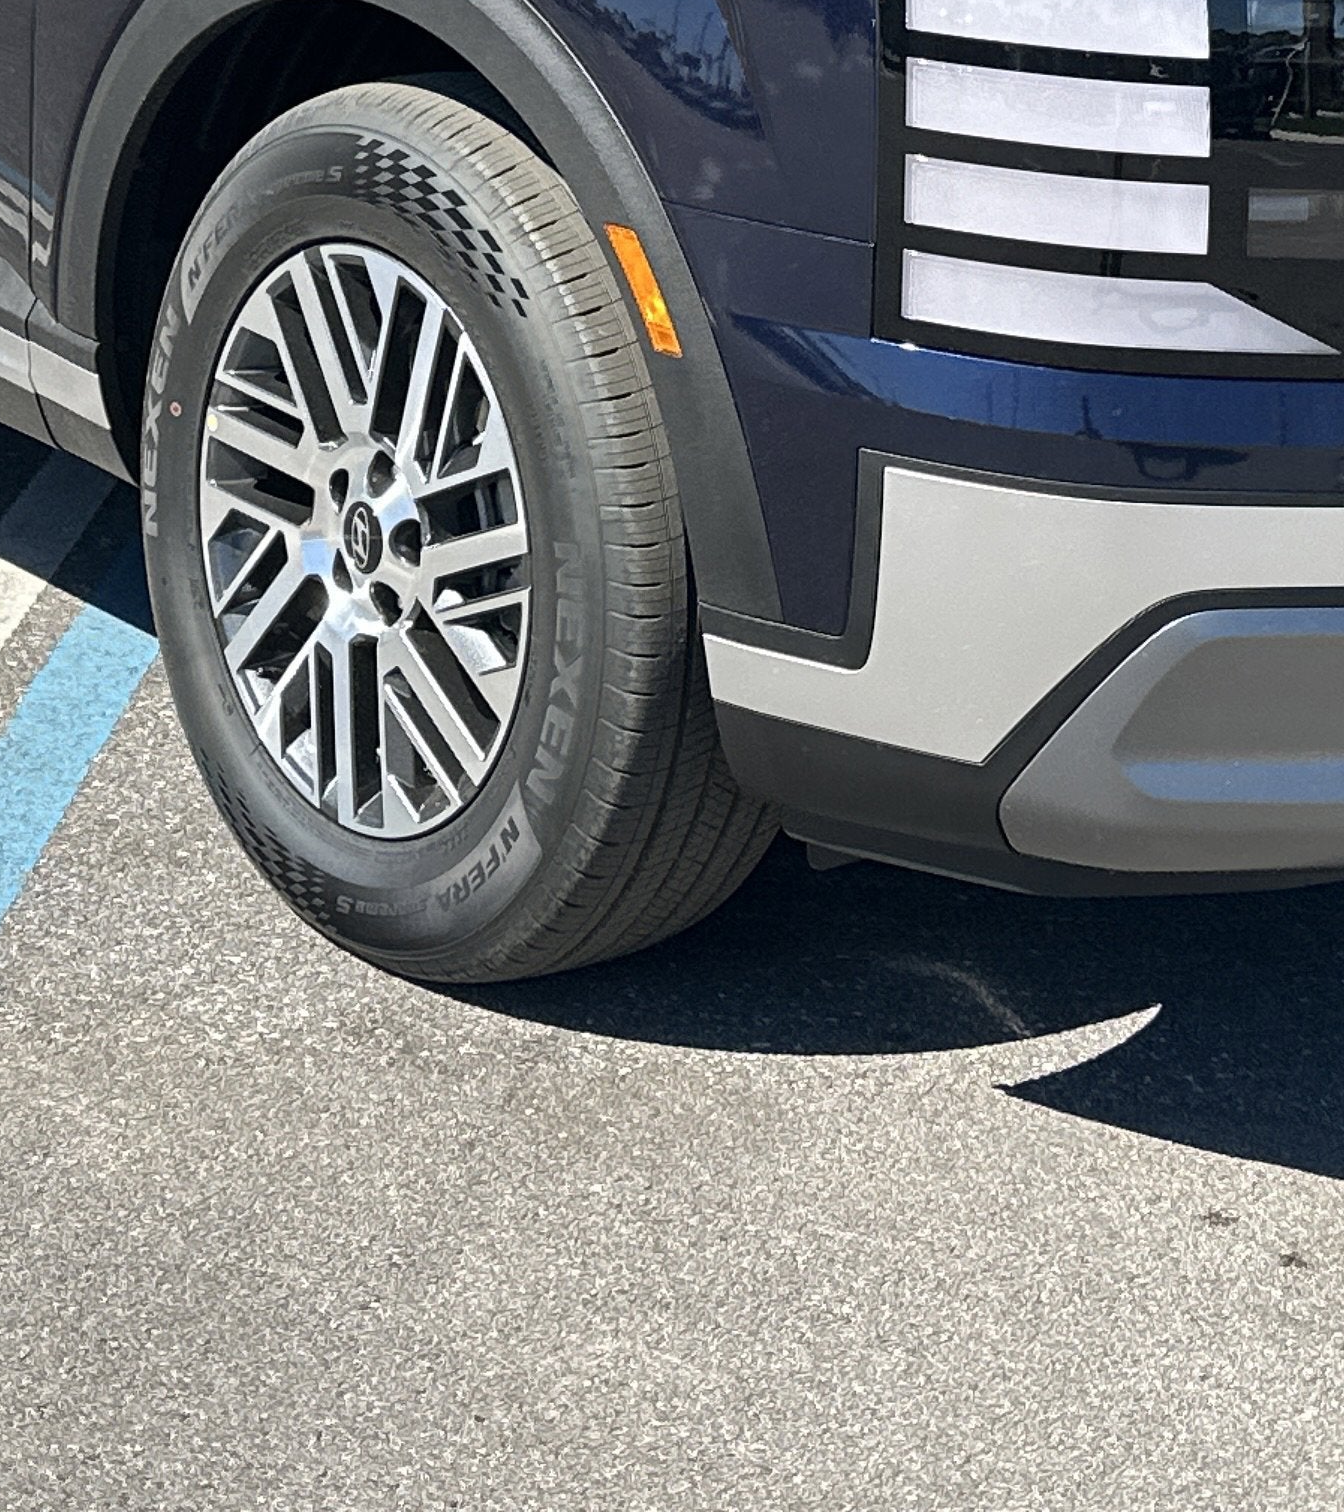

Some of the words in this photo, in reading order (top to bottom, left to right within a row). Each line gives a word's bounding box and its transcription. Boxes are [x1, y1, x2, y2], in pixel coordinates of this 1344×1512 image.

[144, 303, 181, 538] NEXEN
[525, 540, 585, 805] NEXEN
[435, 815, 520, 913] N'FERA
